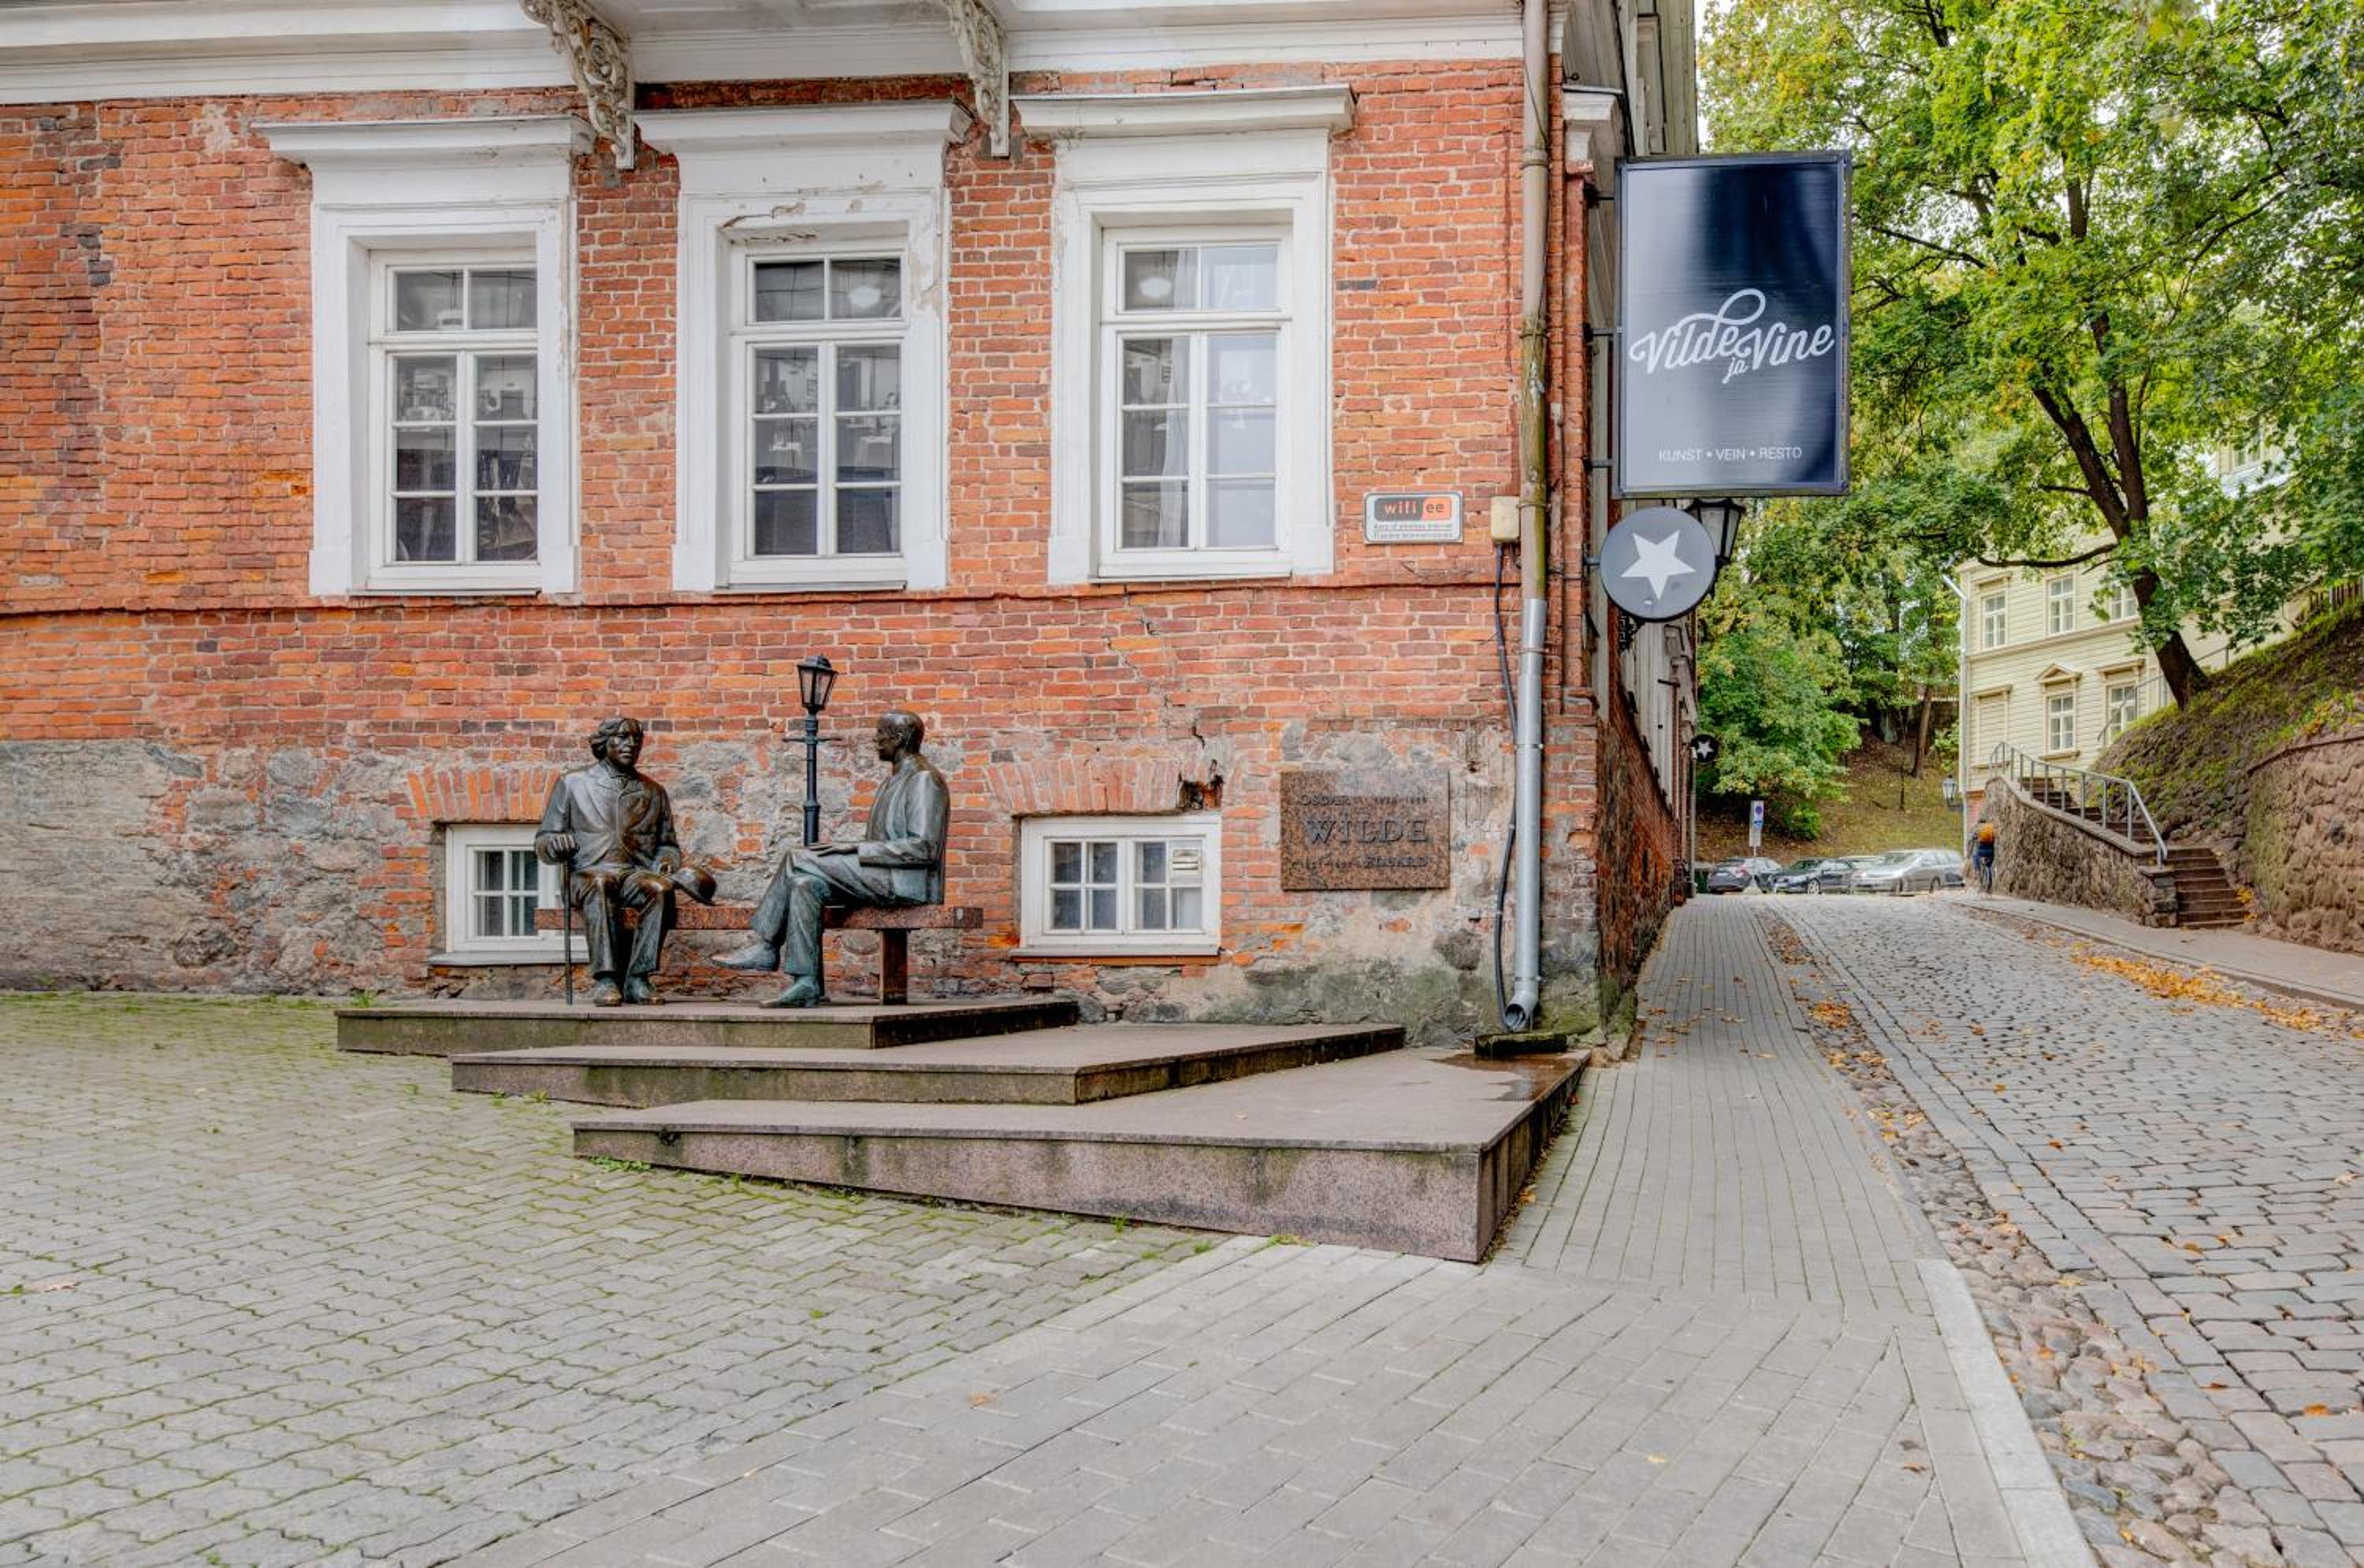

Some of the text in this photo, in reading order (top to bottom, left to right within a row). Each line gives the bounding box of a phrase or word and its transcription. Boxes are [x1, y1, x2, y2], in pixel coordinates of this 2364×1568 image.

[1630, 289, 1765, 373] Vilde
[1735, 322, 1834, 370] Vine
[1659, 447, 1802, 461] KUNST VEIN RESTO
[1305, 819, 1429, 845] WILDE
